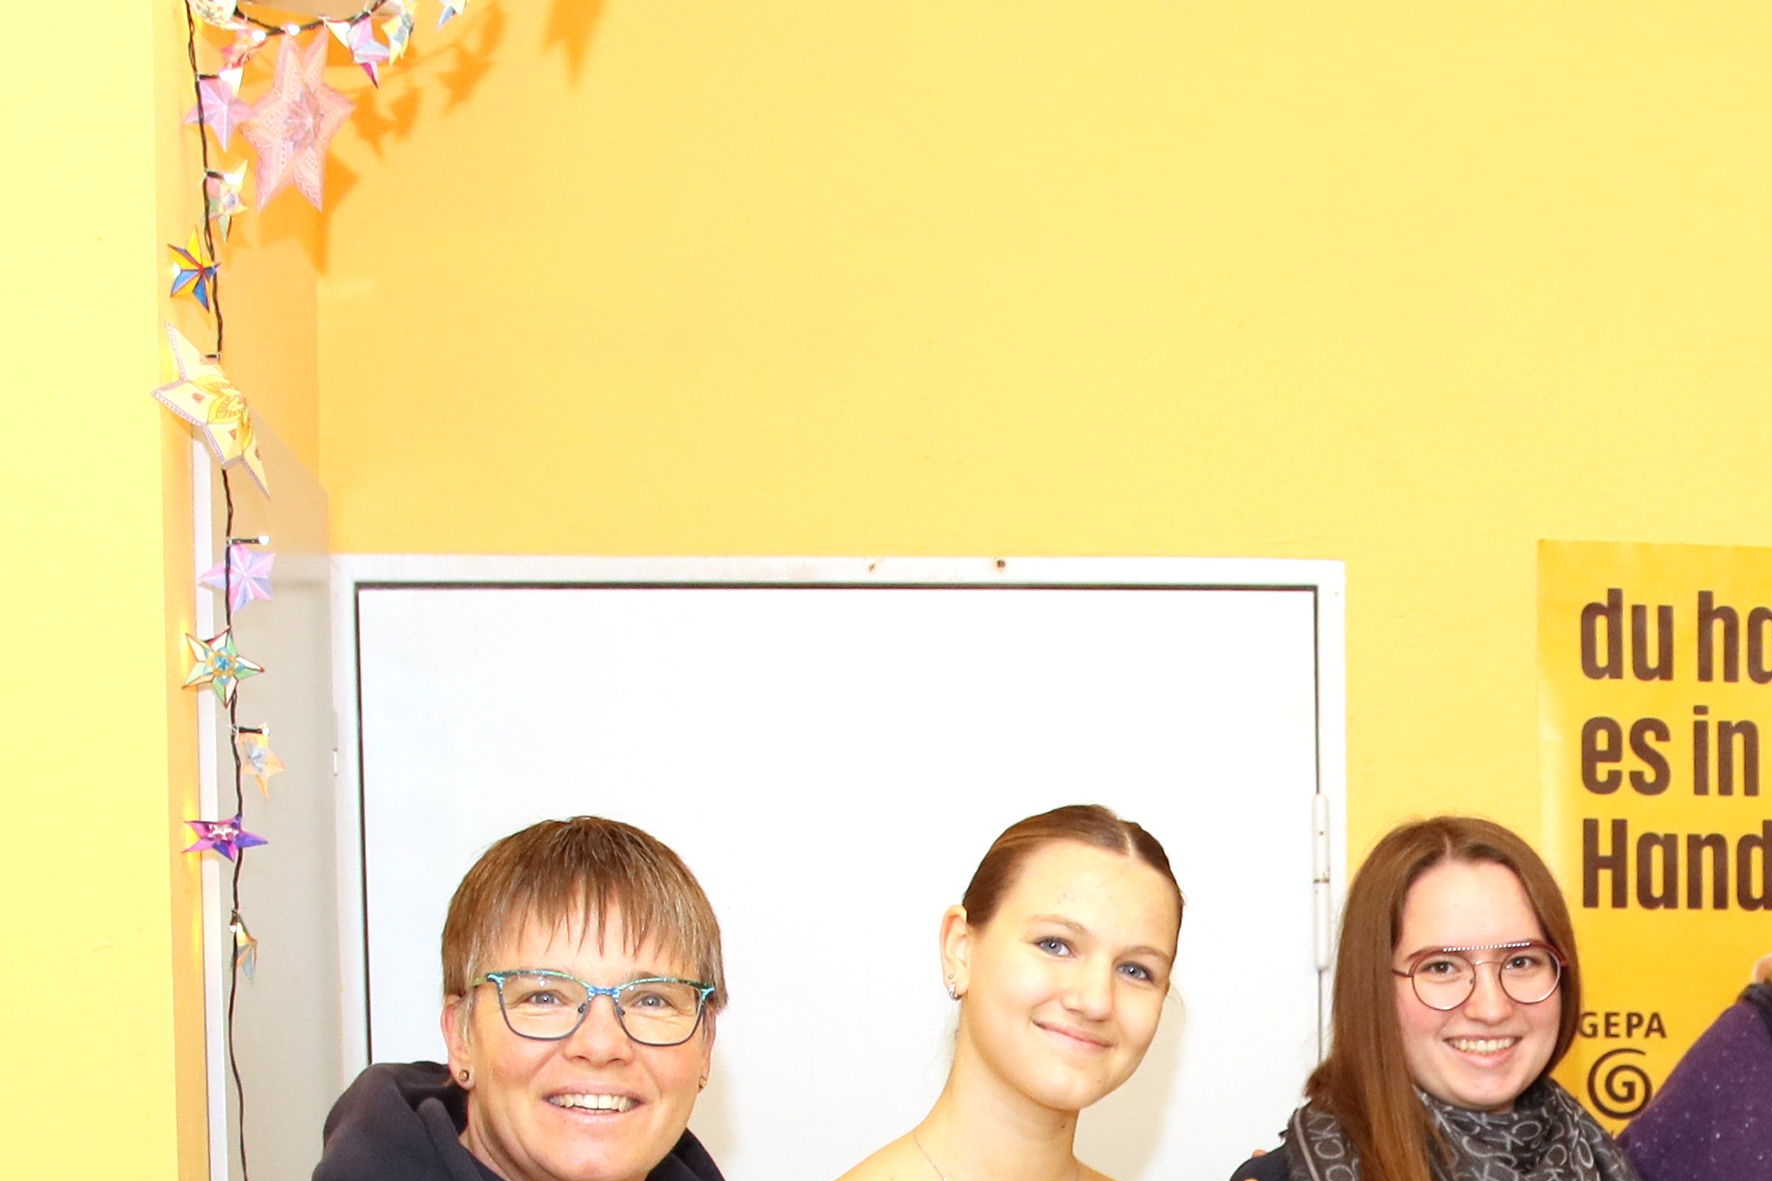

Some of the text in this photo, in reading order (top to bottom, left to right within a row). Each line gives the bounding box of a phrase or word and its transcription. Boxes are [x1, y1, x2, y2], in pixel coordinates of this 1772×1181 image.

[1581, 588, 1674, 681] du
[1582, 716, 1671, 795] es
[1693, 705, 1759, 797] in
[1579, 1011, 1667, 1039] GEPA
